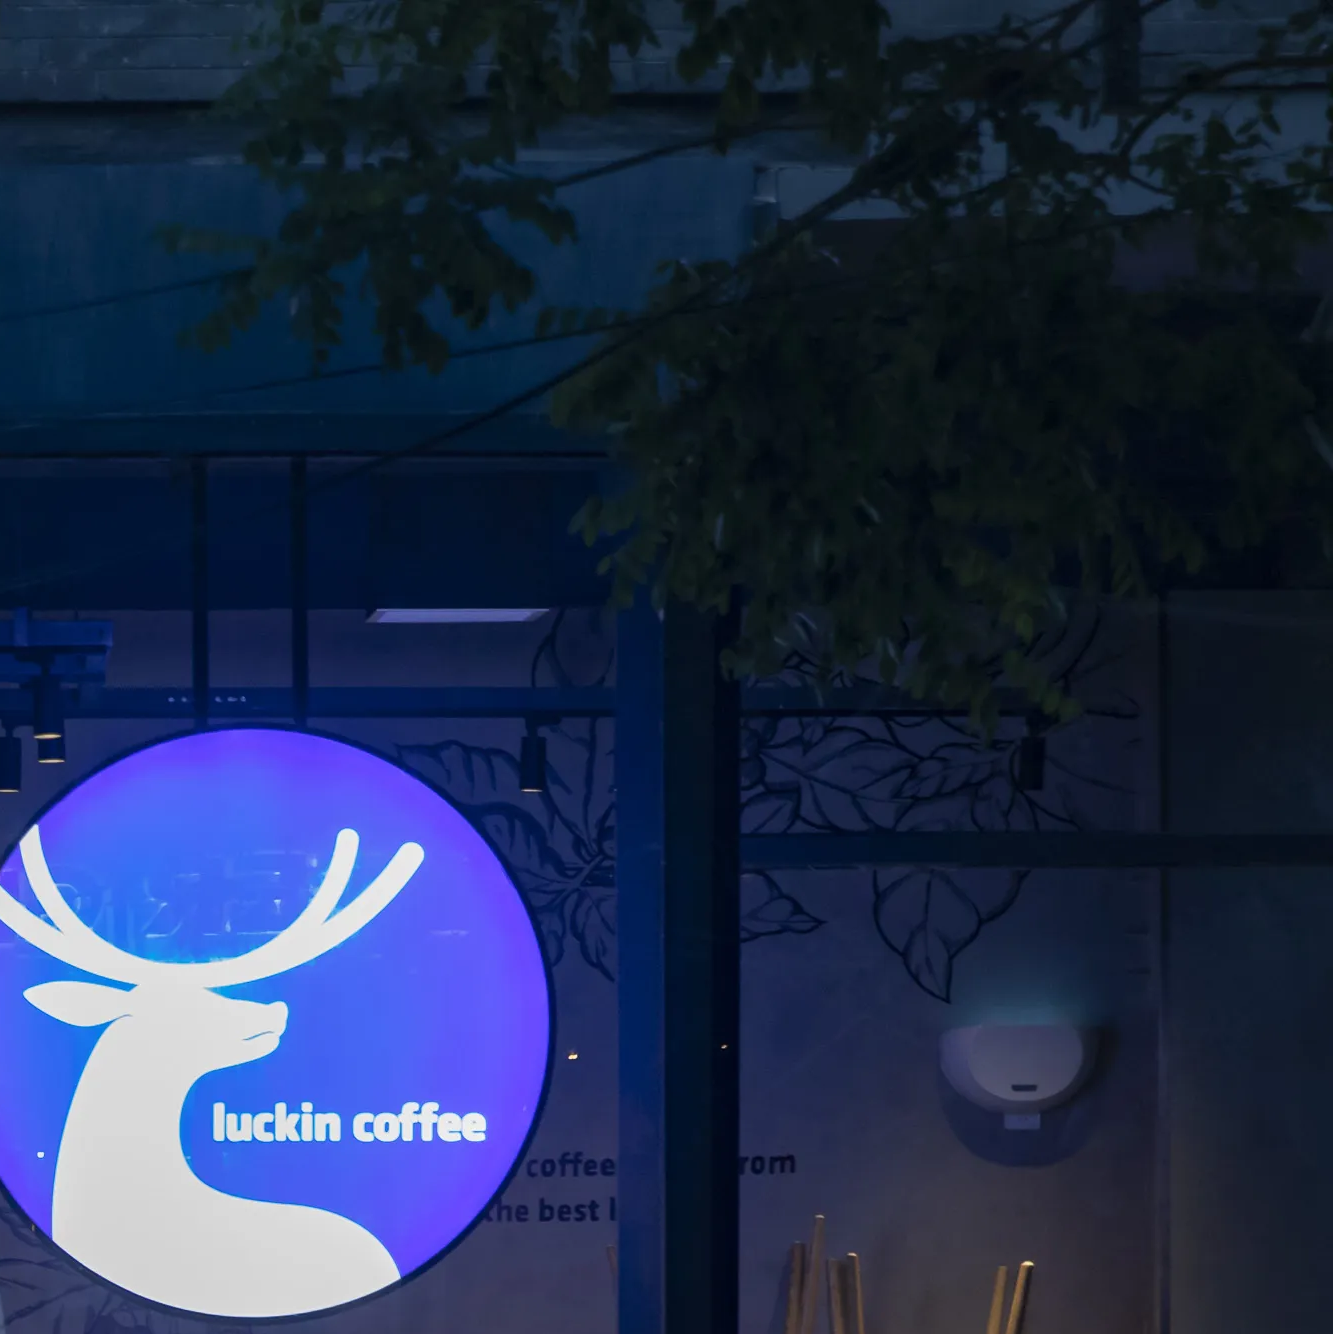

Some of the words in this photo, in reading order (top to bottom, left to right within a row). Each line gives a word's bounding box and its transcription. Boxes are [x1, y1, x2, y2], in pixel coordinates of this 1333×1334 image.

[213, 1102, 341, 1142] luckin
[352, 1101, 487, 1142] coffee
[526, 1151, 617, 1178] coffee
[735, 1153, 796, 1175] rom
[538, 1196, 600, 1222] best
